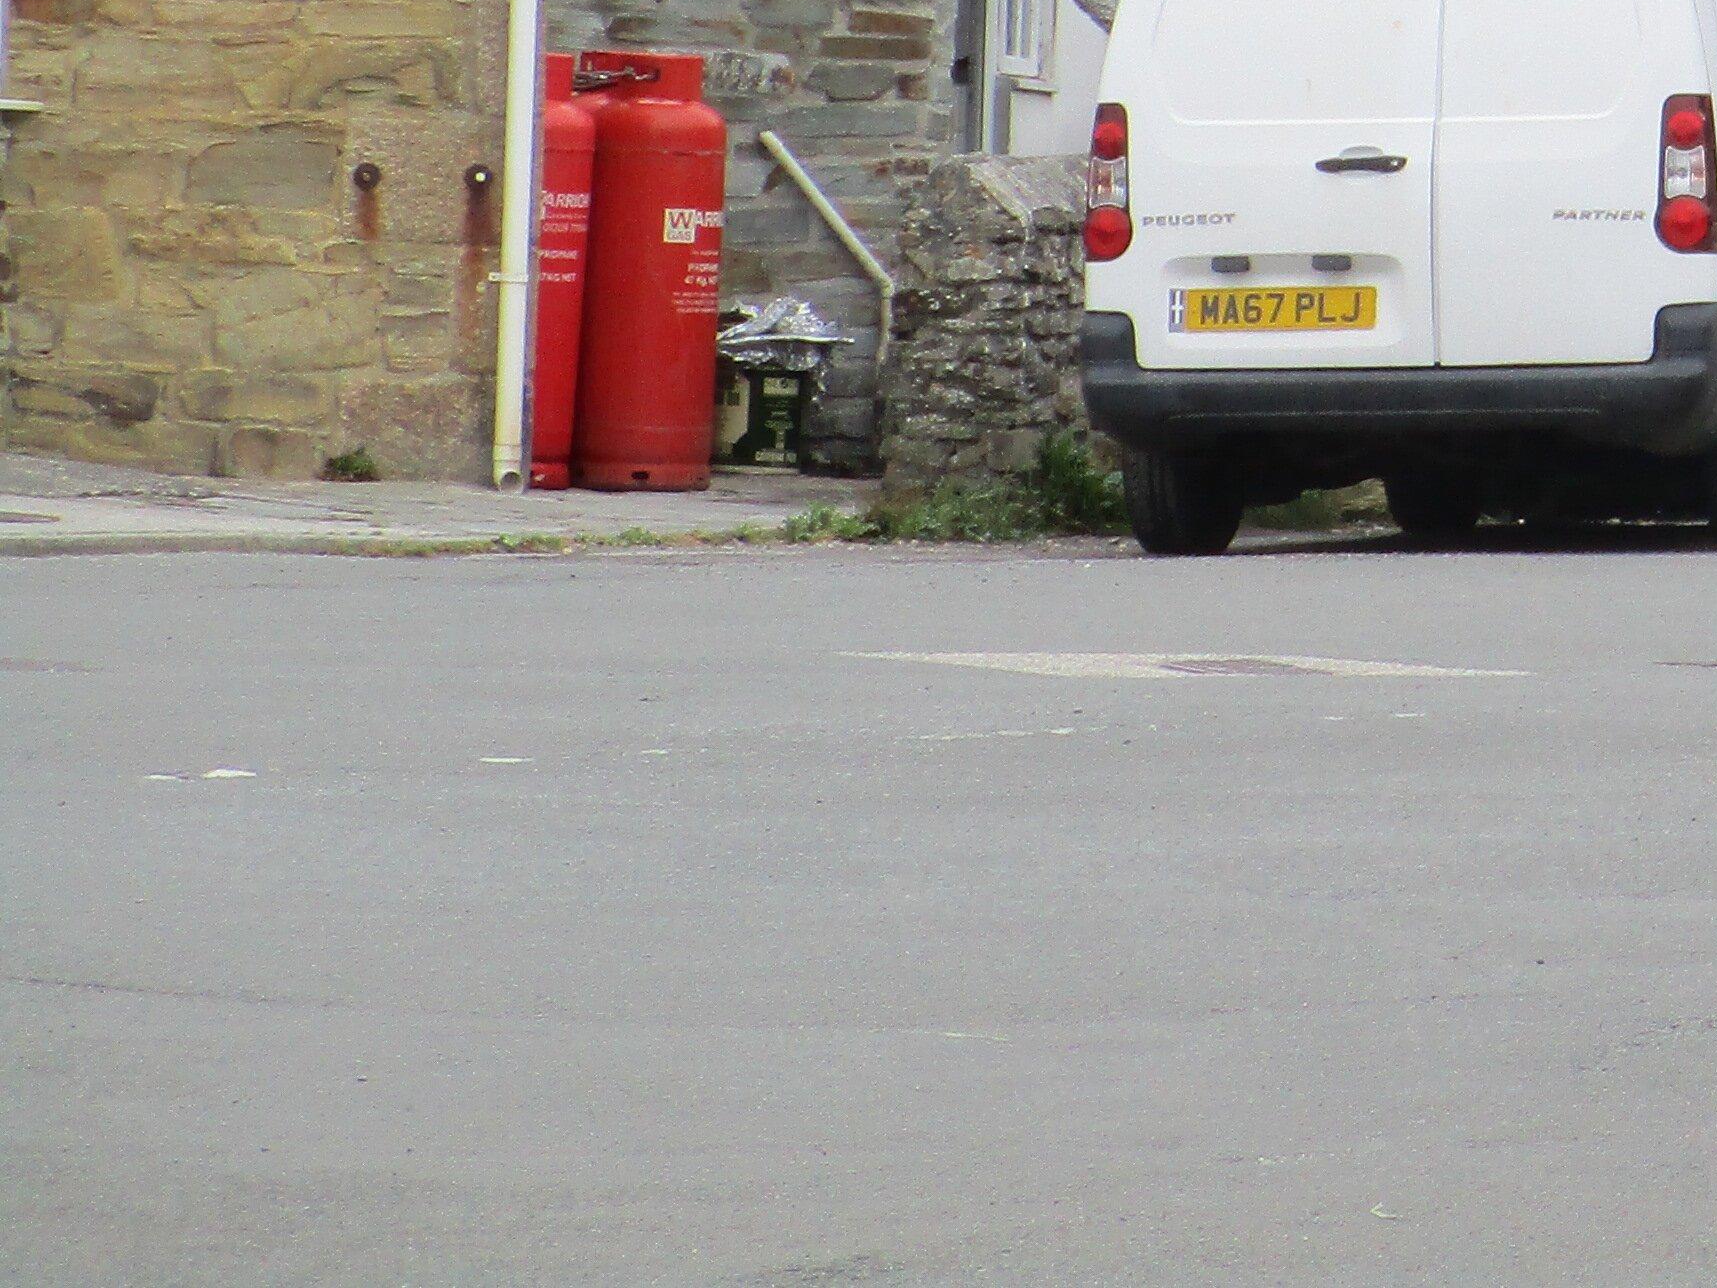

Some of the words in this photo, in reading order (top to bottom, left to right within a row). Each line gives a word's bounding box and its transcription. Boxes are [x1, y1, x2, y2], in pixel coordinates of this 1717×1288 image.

[1142, 212, 1236, 226] PEUGEOT
[1552, 209, 1646, 221] PARTNER
[1199, 291, 1286, 326] MA67
[1294, 291, 1362, 324] PLJ
